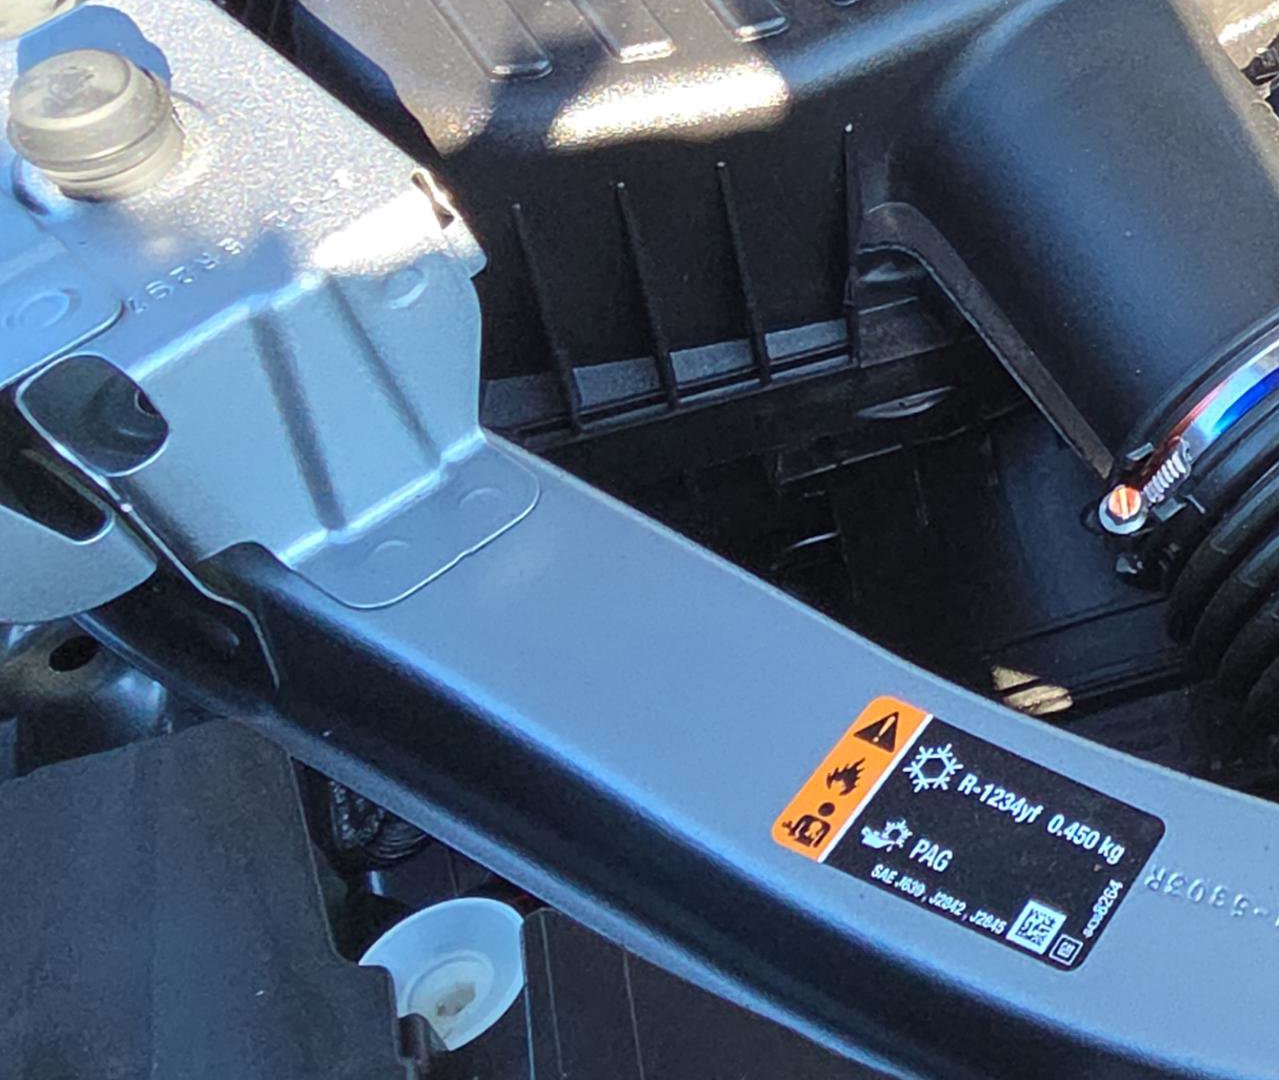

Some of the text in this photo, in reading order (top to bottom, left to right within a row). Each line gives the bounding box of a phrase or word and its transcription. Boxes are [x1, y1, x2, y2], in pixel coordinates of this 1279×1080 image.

[957, 773, 1125, 865] R-1234yf 0.450 kg
[910, 839, 953, 872] PAG
[870, 864, 898, 884] SAE
